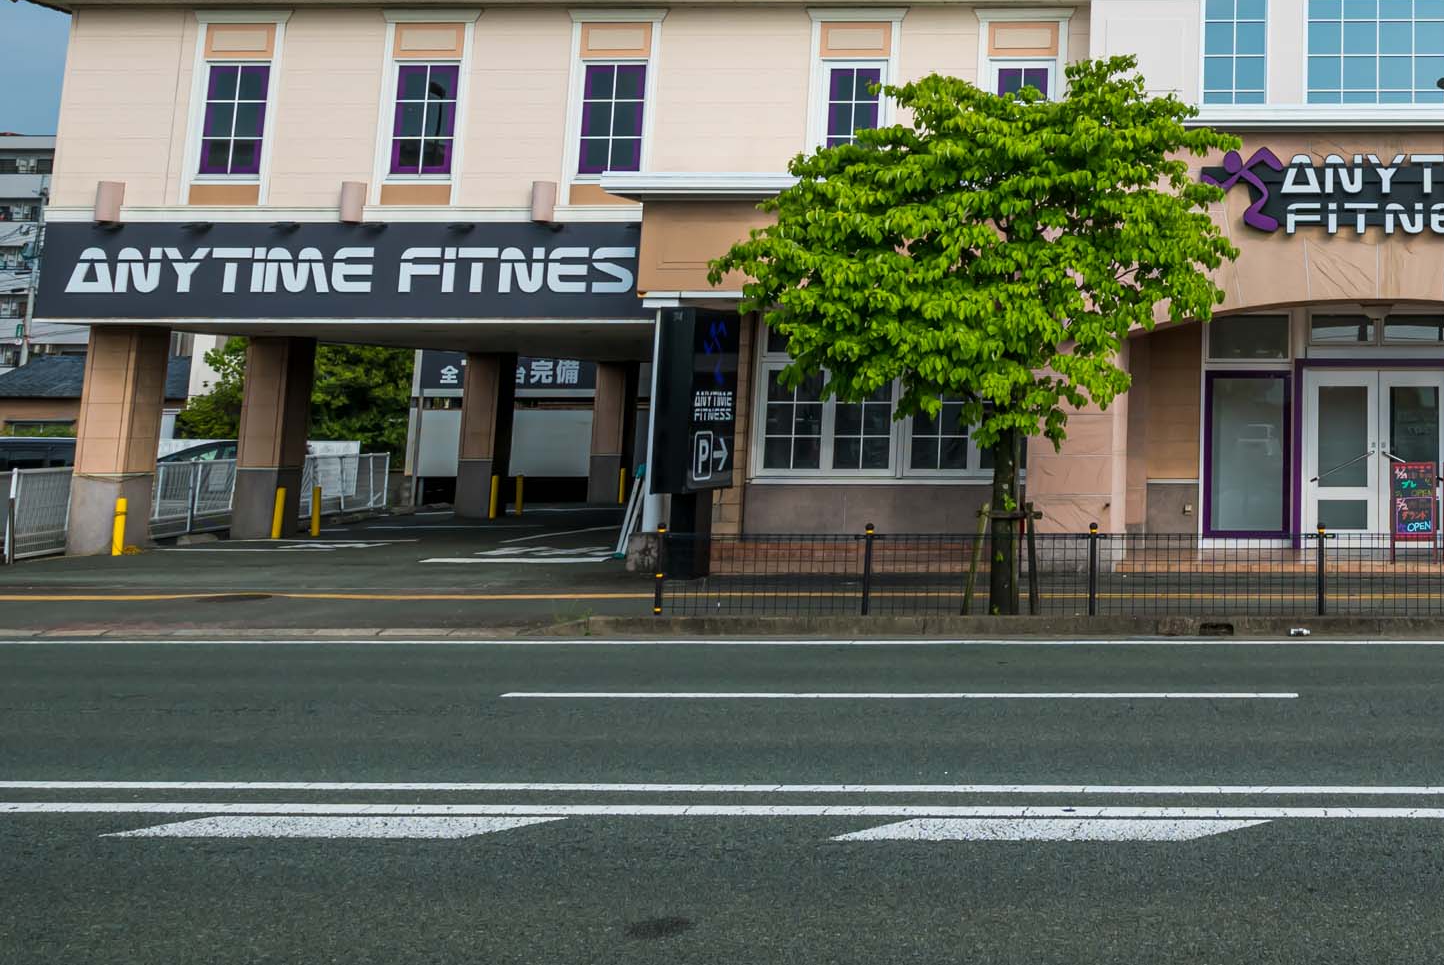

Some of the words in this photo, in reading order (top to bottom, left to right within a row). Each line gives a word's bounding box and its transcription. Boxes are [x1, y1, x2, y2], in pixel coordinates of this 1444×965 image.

[65, 246, 375, 293] ANYTIME
[694, 391, 733, 407] ANYTIME
[694, 408, 731, 421] FITNESS
[698, 439, 709, 474] P
[1407, 521, 1431, 532] OPEN
